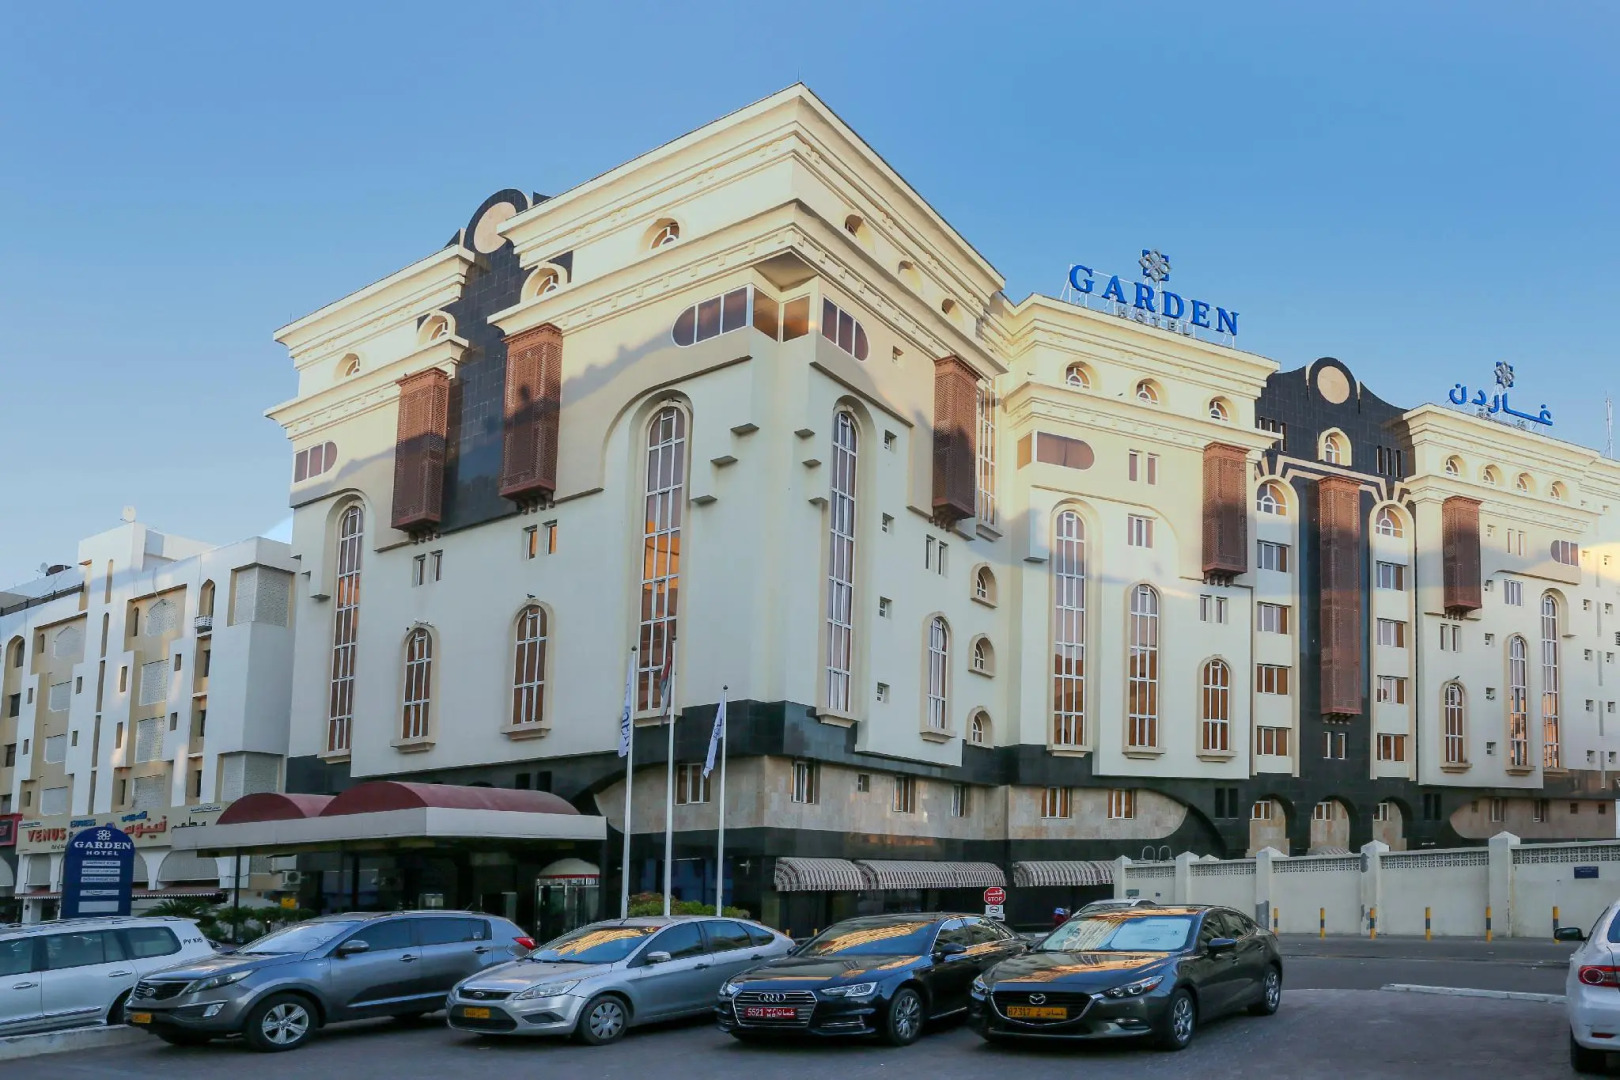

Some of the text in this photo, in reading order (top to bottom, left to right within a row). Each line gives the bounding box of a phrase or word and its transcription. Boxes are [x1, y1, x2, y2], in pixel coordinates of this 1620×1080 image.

[1069, 264, 1240, 336] GARDEN
[1117, 305, 1194, 337] HOTEL
[1448, 383, 1554, 427] غاردن
[28, 828, 67, 842] VENUS
[74, 841, 132, 850] GARDEN
